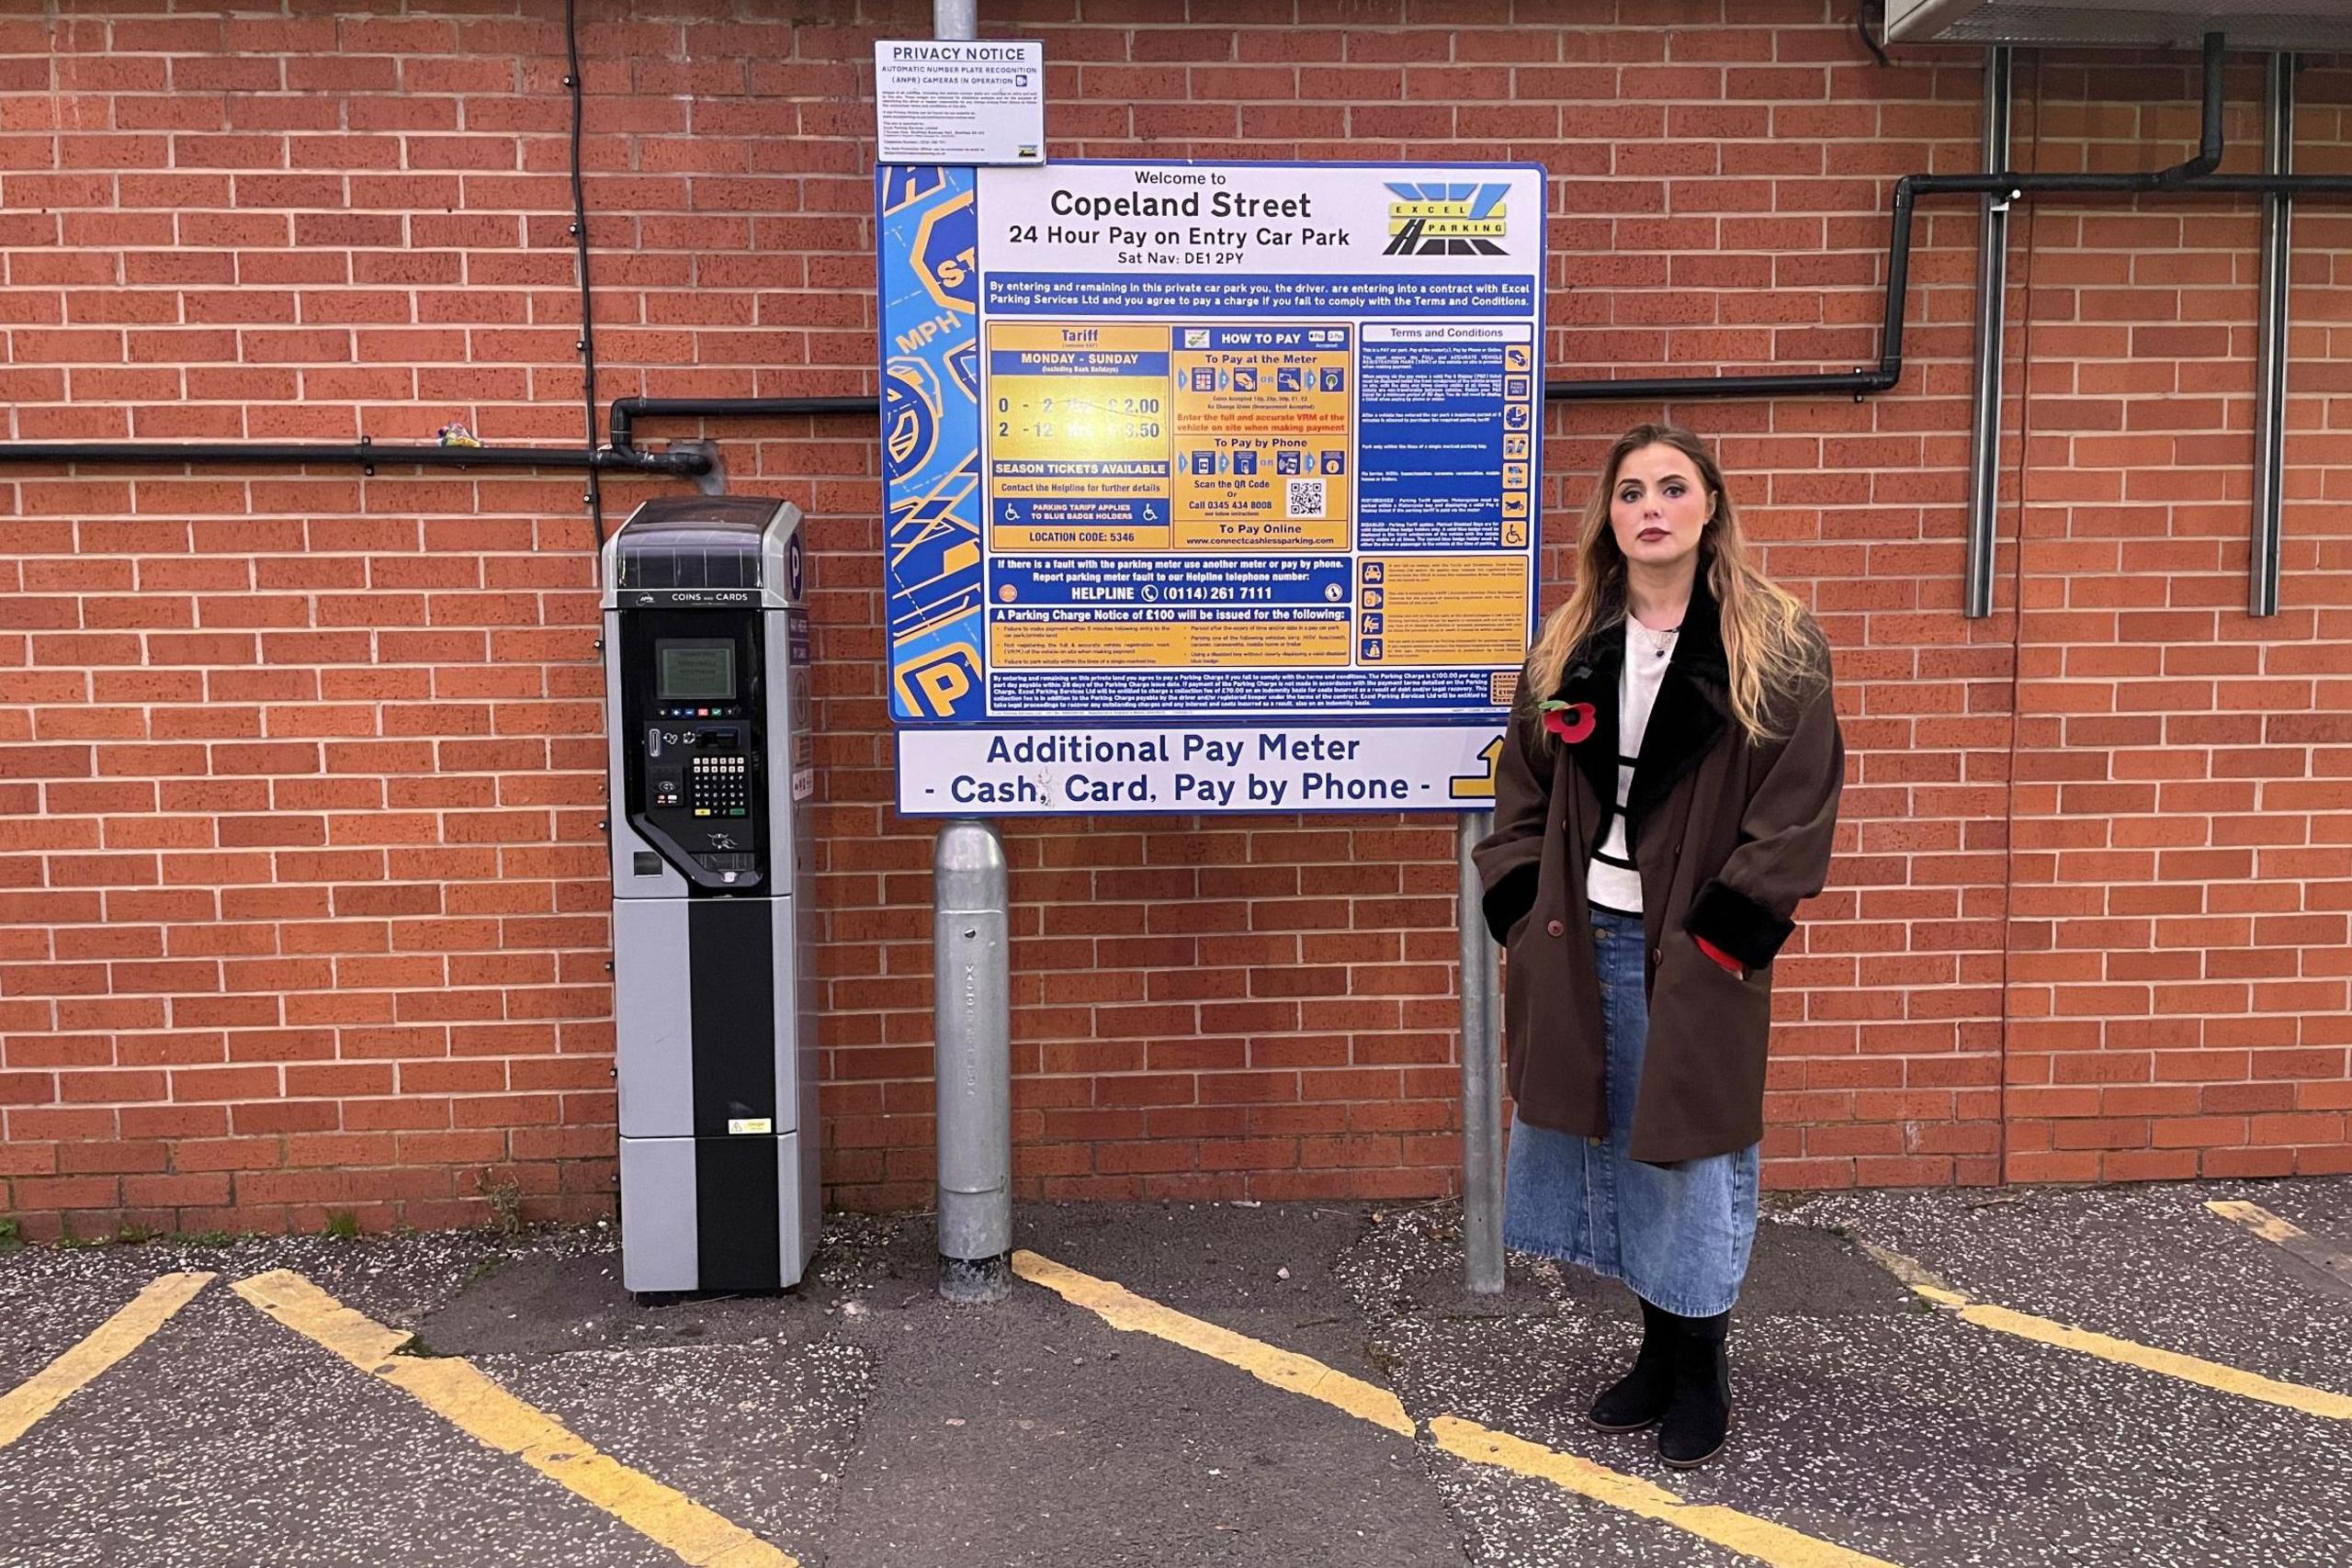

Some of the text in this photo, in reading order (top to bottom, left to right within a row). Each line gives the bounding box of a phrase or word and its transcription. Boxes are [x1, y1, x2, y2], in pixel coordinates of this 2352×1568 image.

[894, 48, 1025, 60] PRIVACY NOTICE
[1135, 171, 1226, 185] Welcome to
[1051, 190, 1312, 220] Copeland Street
[1396, 206, 1465, 214] EXCEL
[1428, 224, 1503, 232] PARKING
[1009, 225, 1349, 248] 24 Hour Pay on Entry Car Park
[1117, 252, 1243, 264] Sat Nav: DE1 2PY
[990, 281, 1003, 294] By
[1007, 281, 1050, 292] entering
[1053, 282, 1072, 290] and
[1075, 282, 1126, 293] remaining
[1130, 283, 1139, 291] in
[1142, 283, 1161, 291] this
[1165, 283, 1201, 293] private
[1224, 283, 1247, 293] park
[1275, 284, 1292, 292] the
[1351, 284, 1394, 294] entering
[1397, 284, 1417, 292] into
[1430, 284, 1472, 293] contract
[1476, 284, 1498, 293] with
[1501, 284, 1529, 293] Excel
[990, 294, 1030, 305] Parking
[1034, 294, 1078, 303] Services
[1082, 295, 1099, 303] Ltd
[1102, 295, 1121, 304] and
[1125, 298, 1143, 306] you
[1147, 298, 1175, 306] agree
[1179, 296, 1189, 304] to
[1193, 298, 1211, 306] pay
[1224, 295, 1259, 306] charge
[1272, 299, 1291, 307] you
[1295, 296, 1310, 305] fail
[1314, 297, 1325, 305] to
[1329, 296, 1365, 306] comply
[1368, 296, 1390, 305] with
[1394, 297, 1411, 305] the
[1414, 296, 1445, 305] Terms
[1449, 297, 1467, 305] and
[1472, 297, 1529, 305] Conditions.
[895, 310, 962, 354] MPH
[1062, 329, 1099, 341] Tariff
[1389, 328, 1503, 336] Terms and Conditions
[1222, 333, 1251, 343] HOW
[1255, 333, 1272, 344] TO
[1275, 333, 1301, 344] PAY
[1022, 353, 1074, 363] MONDAY
[1089, 354, 1137, 364] SUNDAY
[1205, 355, 1317, 365] To Pay at the Meter
[999, 398, 1009, 412] 0
[1125, 399, 1159, 413] 2.00
[999, 422, 1009, 436] 2
[1035, 423, 1052, 437] 12
[1125, 423, 1159, 437] 3.50
[1214, 438, 1306, 448] To Pay by Phone
[996, 464, 1165, 474] SEASON TICKETS AVAILABLE
[1051, 484, 1084, 492] Helpline
[1194, 479, 1215, 488] Scan
[1234, 479, 1246, 489] QR
[1249, 479, 1270, 488] Code
[1189, 501, 1204, 509] Call
[1219, 524, 1301, 535] To Pay Online
[1029, 532, 1134, 541] LOCATION CODE: 5346
[1186, 537, 1334, 546] www.connectcashlessparking.com
[1071, 587, 1136, 599] HELPLINE
[1163, 586, 1270, 599] (0114) 261 7111
[997, 610, 1344, 623] A Parking Charge Notice of £100 will be issued for the following:
[915, 662, 969, 716] P
[987, 733, 1360, 766] Additional Pay Meter
[951, 775, 1050, 804] Cash,
[1065, 774, 1156, 802] Card,
[1175, 773, 1235, 803] Pay
[1249, 773, 1287, 802] by
[1303, 773, 1408, 799] Phone
